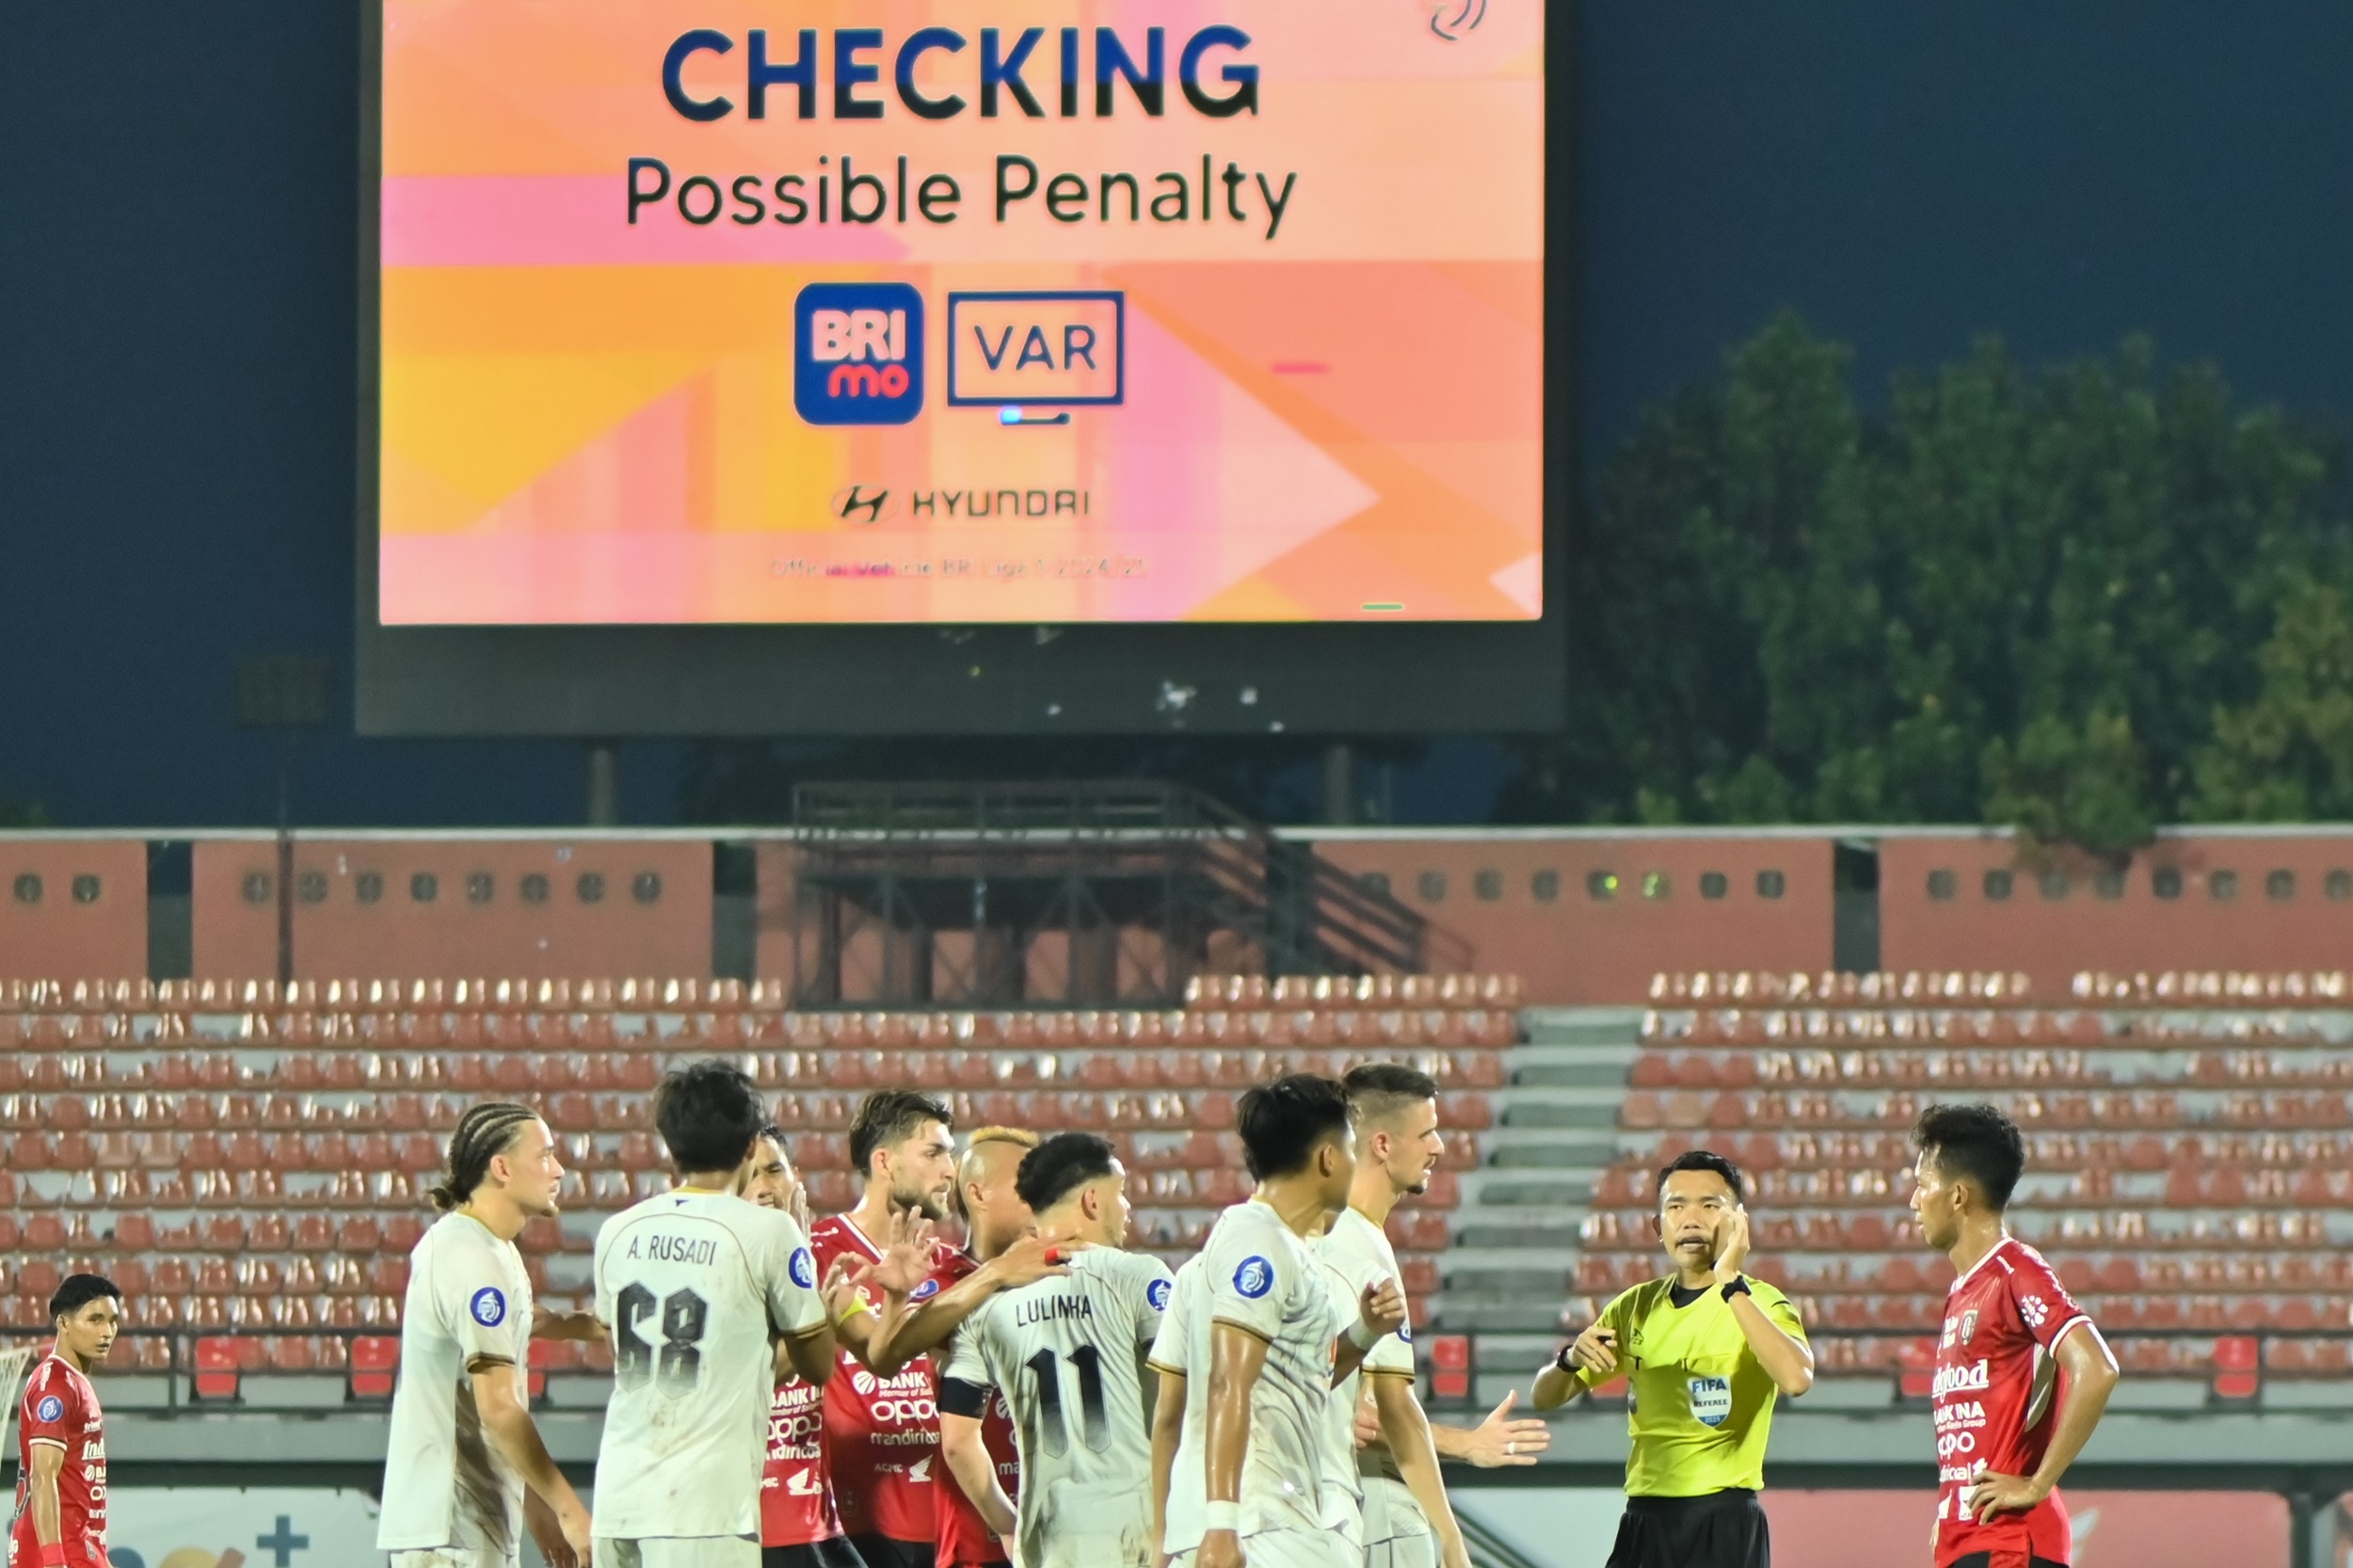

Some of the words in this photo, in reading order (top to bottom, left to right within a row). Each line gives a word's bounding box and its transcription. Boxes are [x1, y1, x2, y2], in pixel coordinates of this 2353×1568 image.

[662, 24, 1258, 121] CHECKING
[627, 154, 961, 225] Possible
[996, 153, 1297, 240] Penalty
[812, 309, 906, 361] BRI
[973, 325, 1096, 371] VAR
[827, 363, 910, 399] mo
[912, 489, 1090, 518] HYUNDAI
[627, 1235, 642, 1260] A.
[648, 1235, 717, 1267] RUSADI
[1016, 1294, 1093, 1328] LULINHA
[616, 1278, 711, 1401] 68
[1023, 1343, 1112, 1460] 11
[1691, 1378, 1727, 1394] FIFA
[1692, 1398, 1728, 1408] REFEREE
